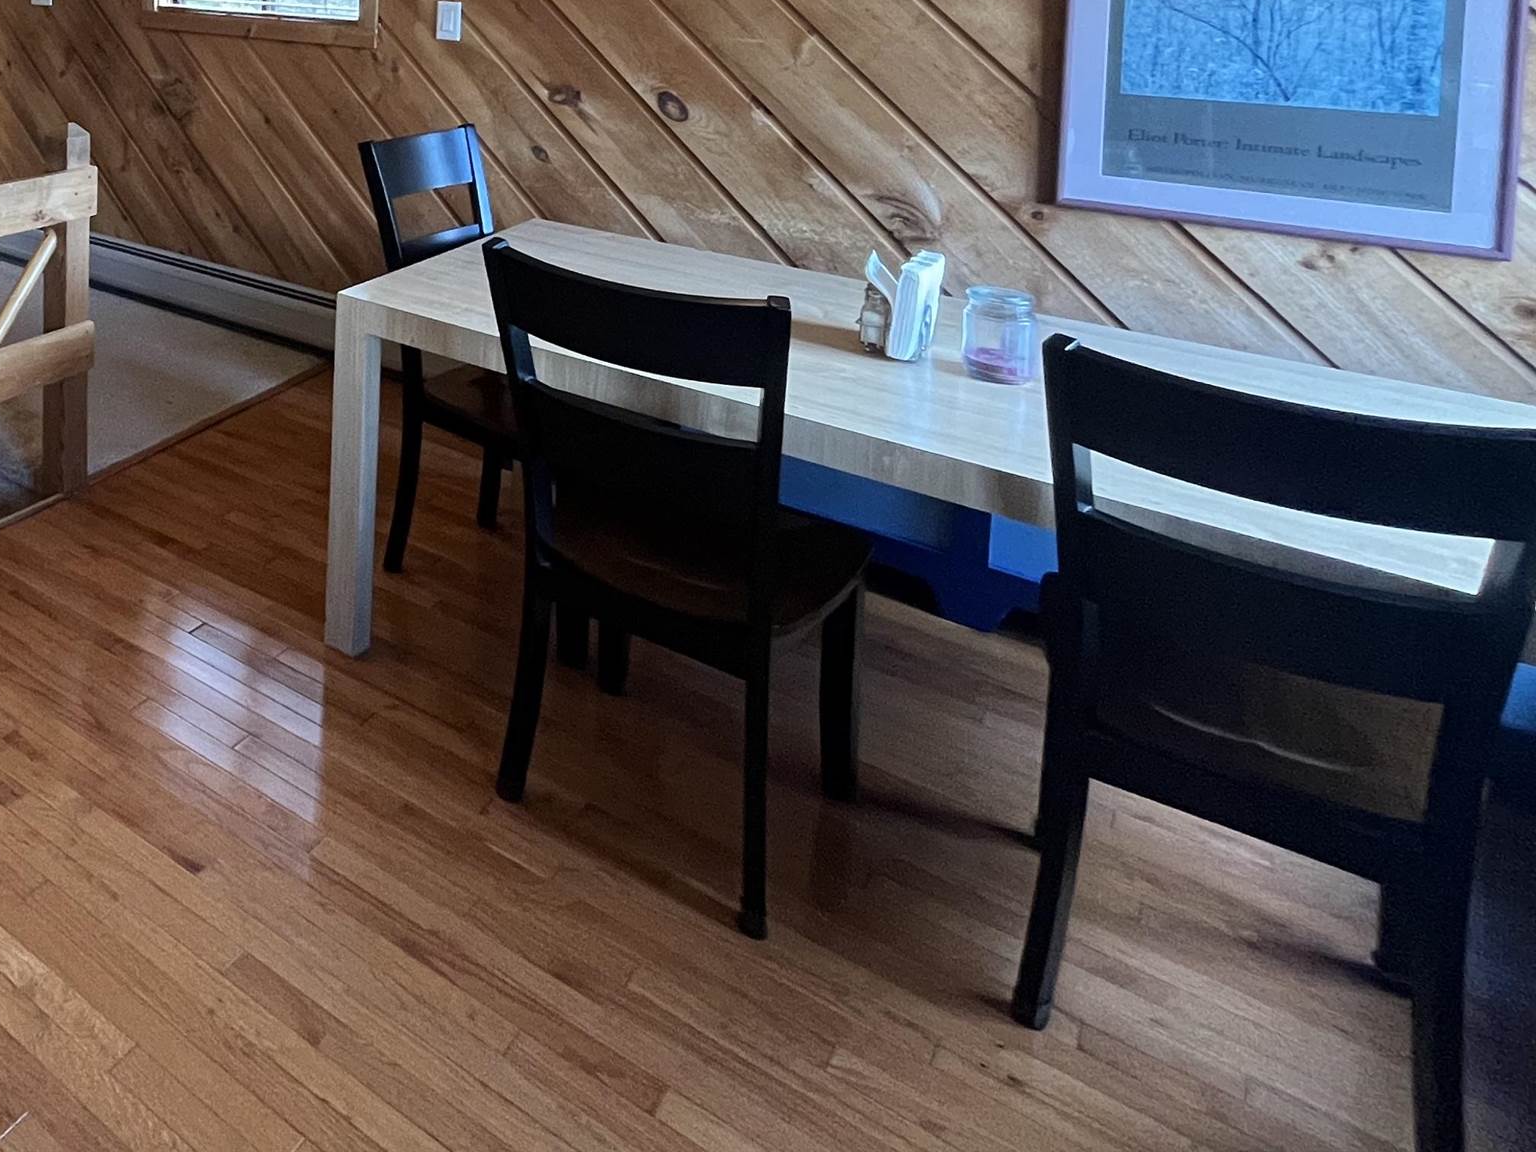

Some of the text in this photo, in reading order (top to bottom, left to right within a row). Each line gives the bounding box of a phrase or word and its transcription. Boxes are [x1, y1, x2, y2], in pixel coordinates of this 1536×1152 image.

[1128, 128, 1168, 144] Eliot
[1235, 137, 1310, 157] Intimate
[1317, 145, 1423, 170] Landscapes
